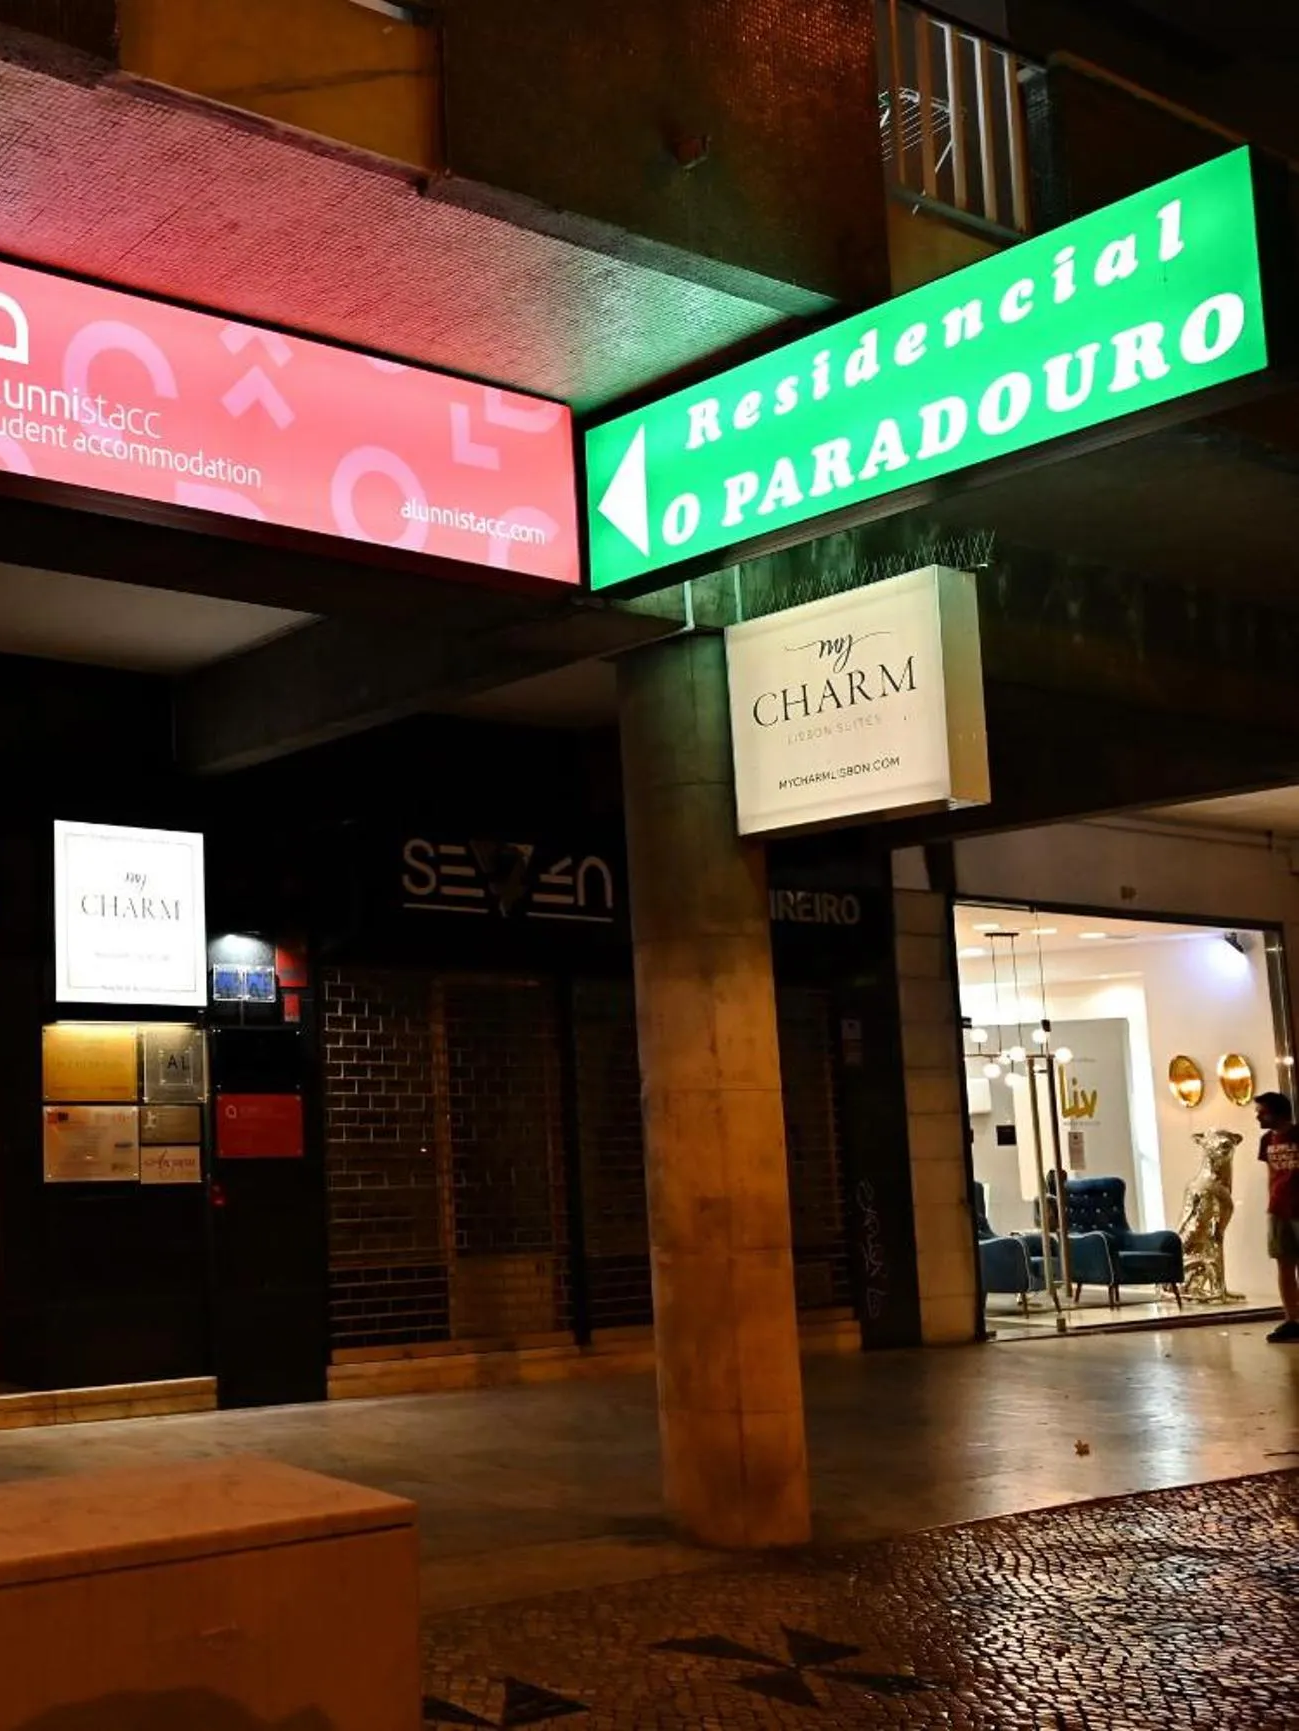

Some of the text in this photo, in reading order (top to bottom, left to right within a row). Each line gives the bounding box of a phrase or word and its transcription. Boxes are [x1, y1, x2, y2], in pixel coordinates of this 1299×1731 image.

[686, 199, 1185, 451] Residencial
[662, 293, 1245, 547] O PARADOURO
[72, 430, 262, 488] accommodation
[401, 499, 545, 545] alunnistacc.com
[753, 655, 917, 728] CHARM
[787, 714, 882, 745] LISBON SUITES
[779, 756, 900, 790] MYCHARMLISBON.COM
[81, 893, 181, 921] CHARM
[769, 888, 861, 925] IREIRO
